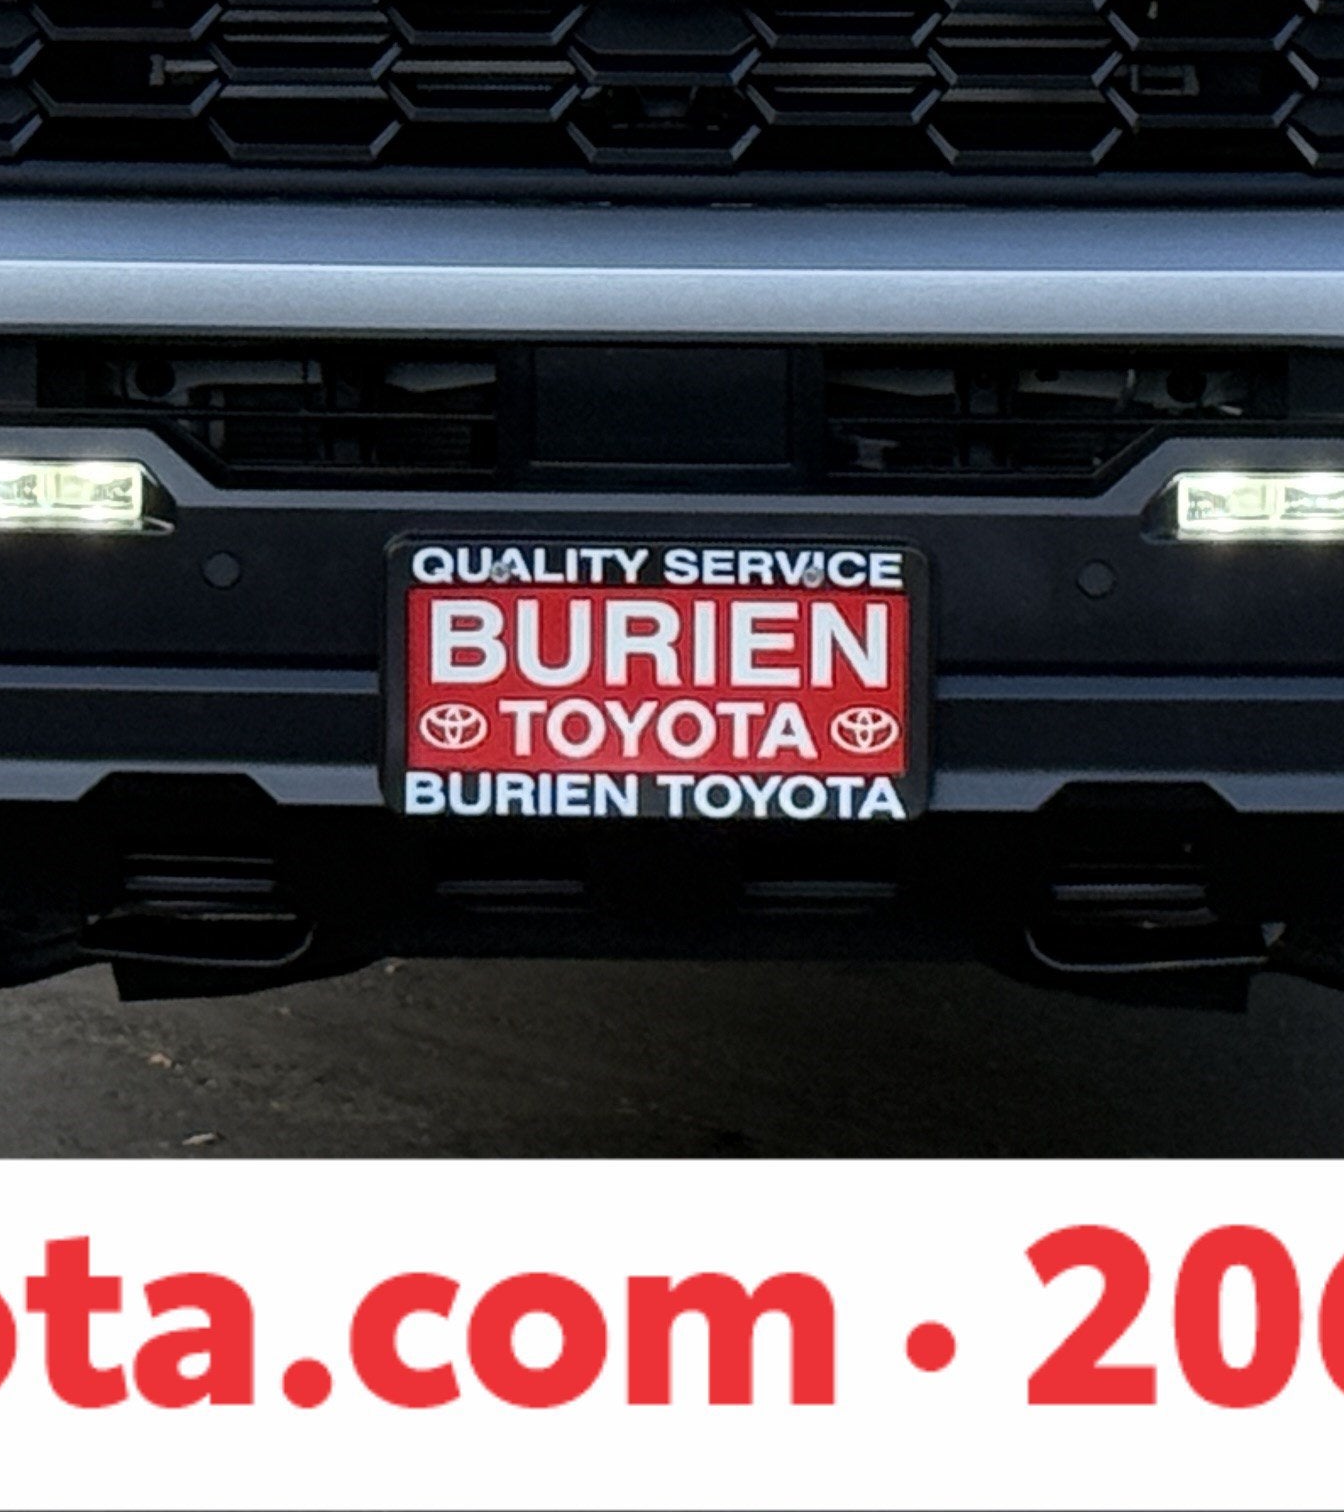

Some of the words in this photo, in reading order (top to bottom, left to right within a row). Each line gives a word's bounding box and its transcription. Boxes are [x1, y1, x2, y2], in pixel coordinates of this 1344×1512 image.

[412, 547, 649, 584] QUALITY
[664, 548, 904, 588] SERVICE
[430, 598, 889, 689] BURIEN
[498, 697, 819, 761] TOYOTA
[404, 770, 639, 817] BURIEN
[656, 774, 907, 820] TOYOTA
